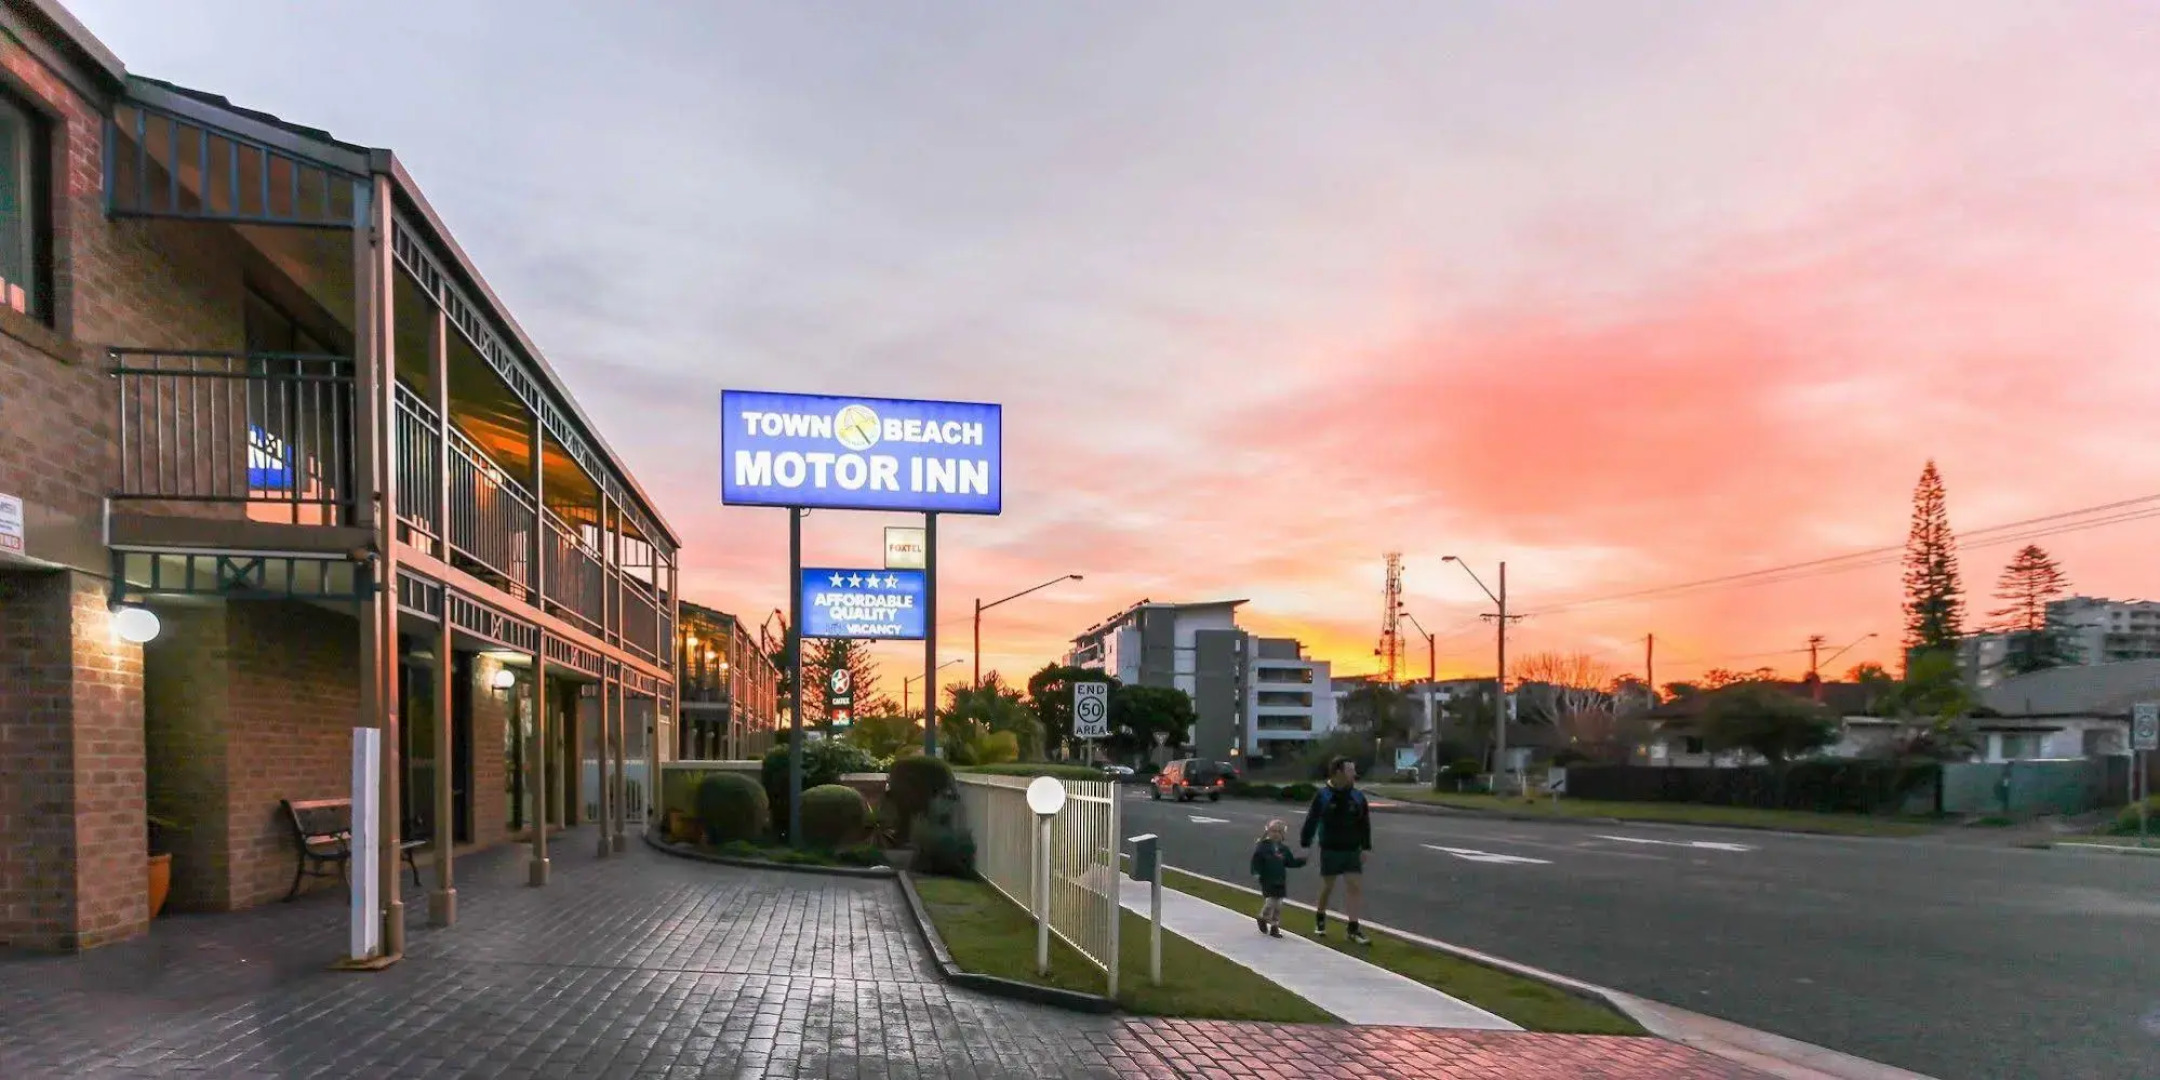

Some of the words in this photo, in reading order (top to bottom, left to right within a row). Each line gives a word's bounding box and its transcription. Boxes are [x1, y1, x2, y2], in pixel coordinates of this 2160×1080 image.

[742, 411, 831, 439] TOWN
[883, 418, 983, 446] BEACH
[735, 450, 900, 491] MOTOR
[911, 457, 989, 495] INN
[889, 544, 922, 553] FOXTEL
[814, 593, 913, 608] AFFORDABLE
[829, 607, 897, 621] QUALITY
[846, 623, 902, 635] VACANCY
[1077, 685, 1105, 694] END
[1081, 703, 1101, 717] 50
[1076, 725, 1106, 735] AREA
